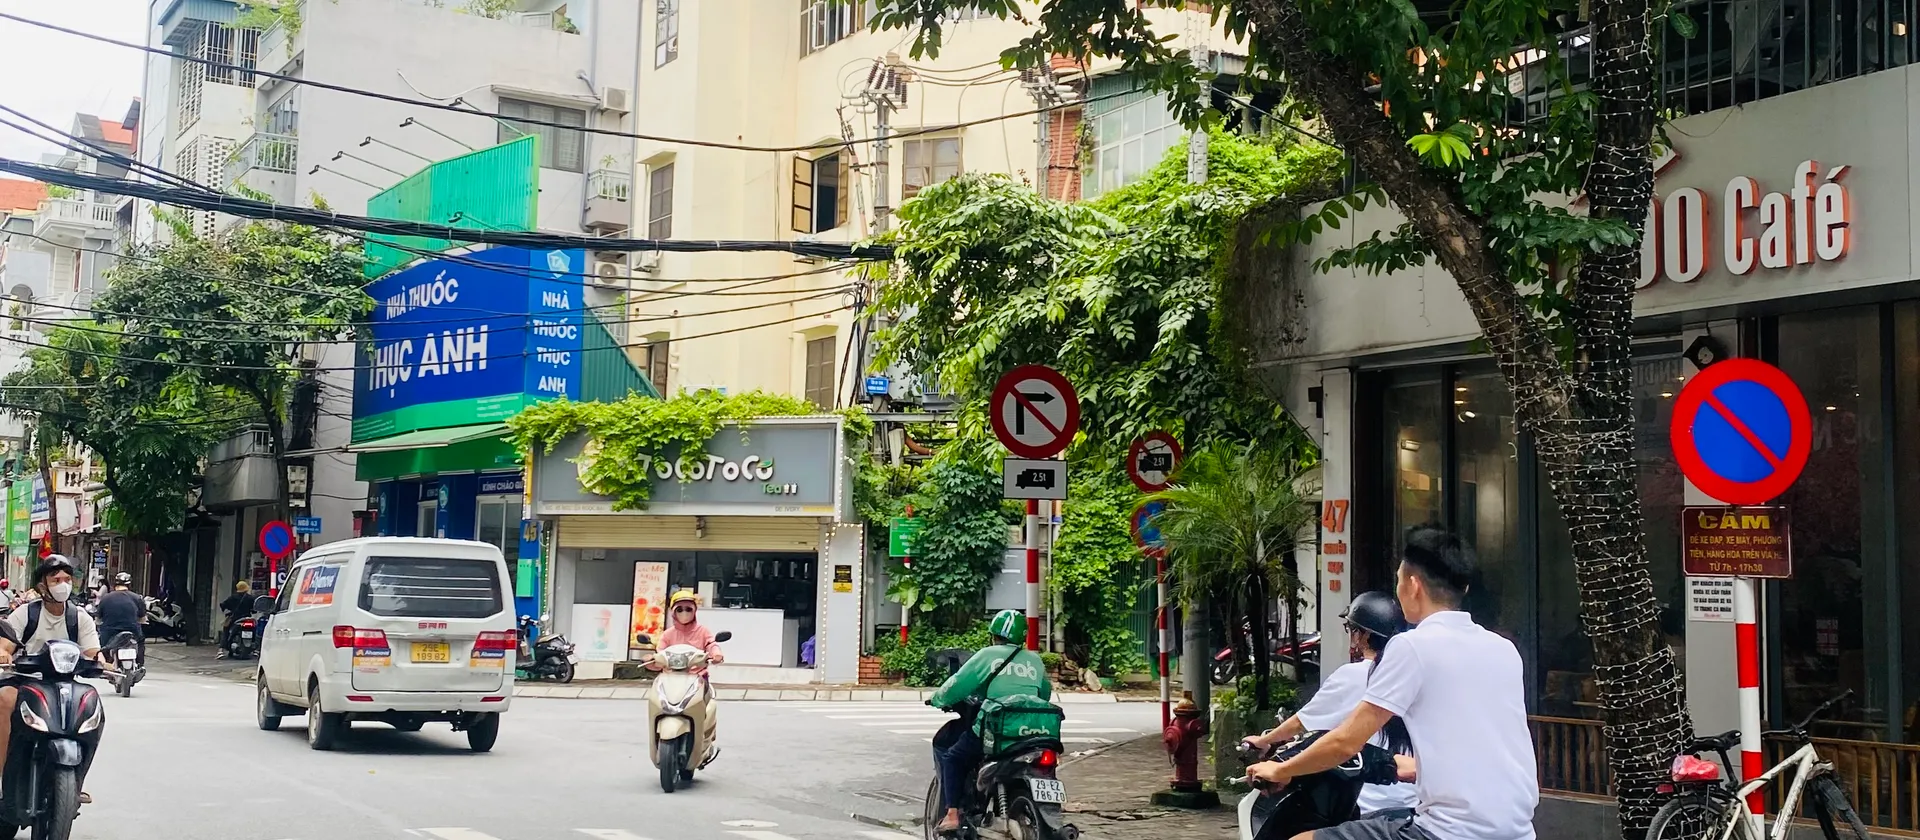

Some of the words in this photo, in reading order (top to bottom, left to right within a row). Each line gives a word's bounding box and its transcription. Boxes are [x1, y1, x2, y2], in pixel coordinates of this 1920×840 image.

[1724, 160, 1851, 275] Café
[386, 288, 407, 320] NHÀ
[408, 270, 459, 311] THUỐC
[542, 290, 570, 310] NHÀ
[532, 317, 577, 340] THUỐC
[418, 324, 488, 379] ANH
[536, 346, 571, 369] THỤC
[538, 375, 567, 394] ANH
[762, 483, 782, 494] Tea
[1322, 499, 1349, 533] 47
[523, 521, 538, 542] 45
[1699, 536, 1708, 544] XE
[1726, 536, 1735, 545] XE
[1742, 548, 1760, 559] TRÊN
[1722, 563, 1732, 571] 7h
[1740, 563, 1763, 572] 17h30
[418, 622, 448, 630] SRM
[990, 658, 1037, 680] Grab
